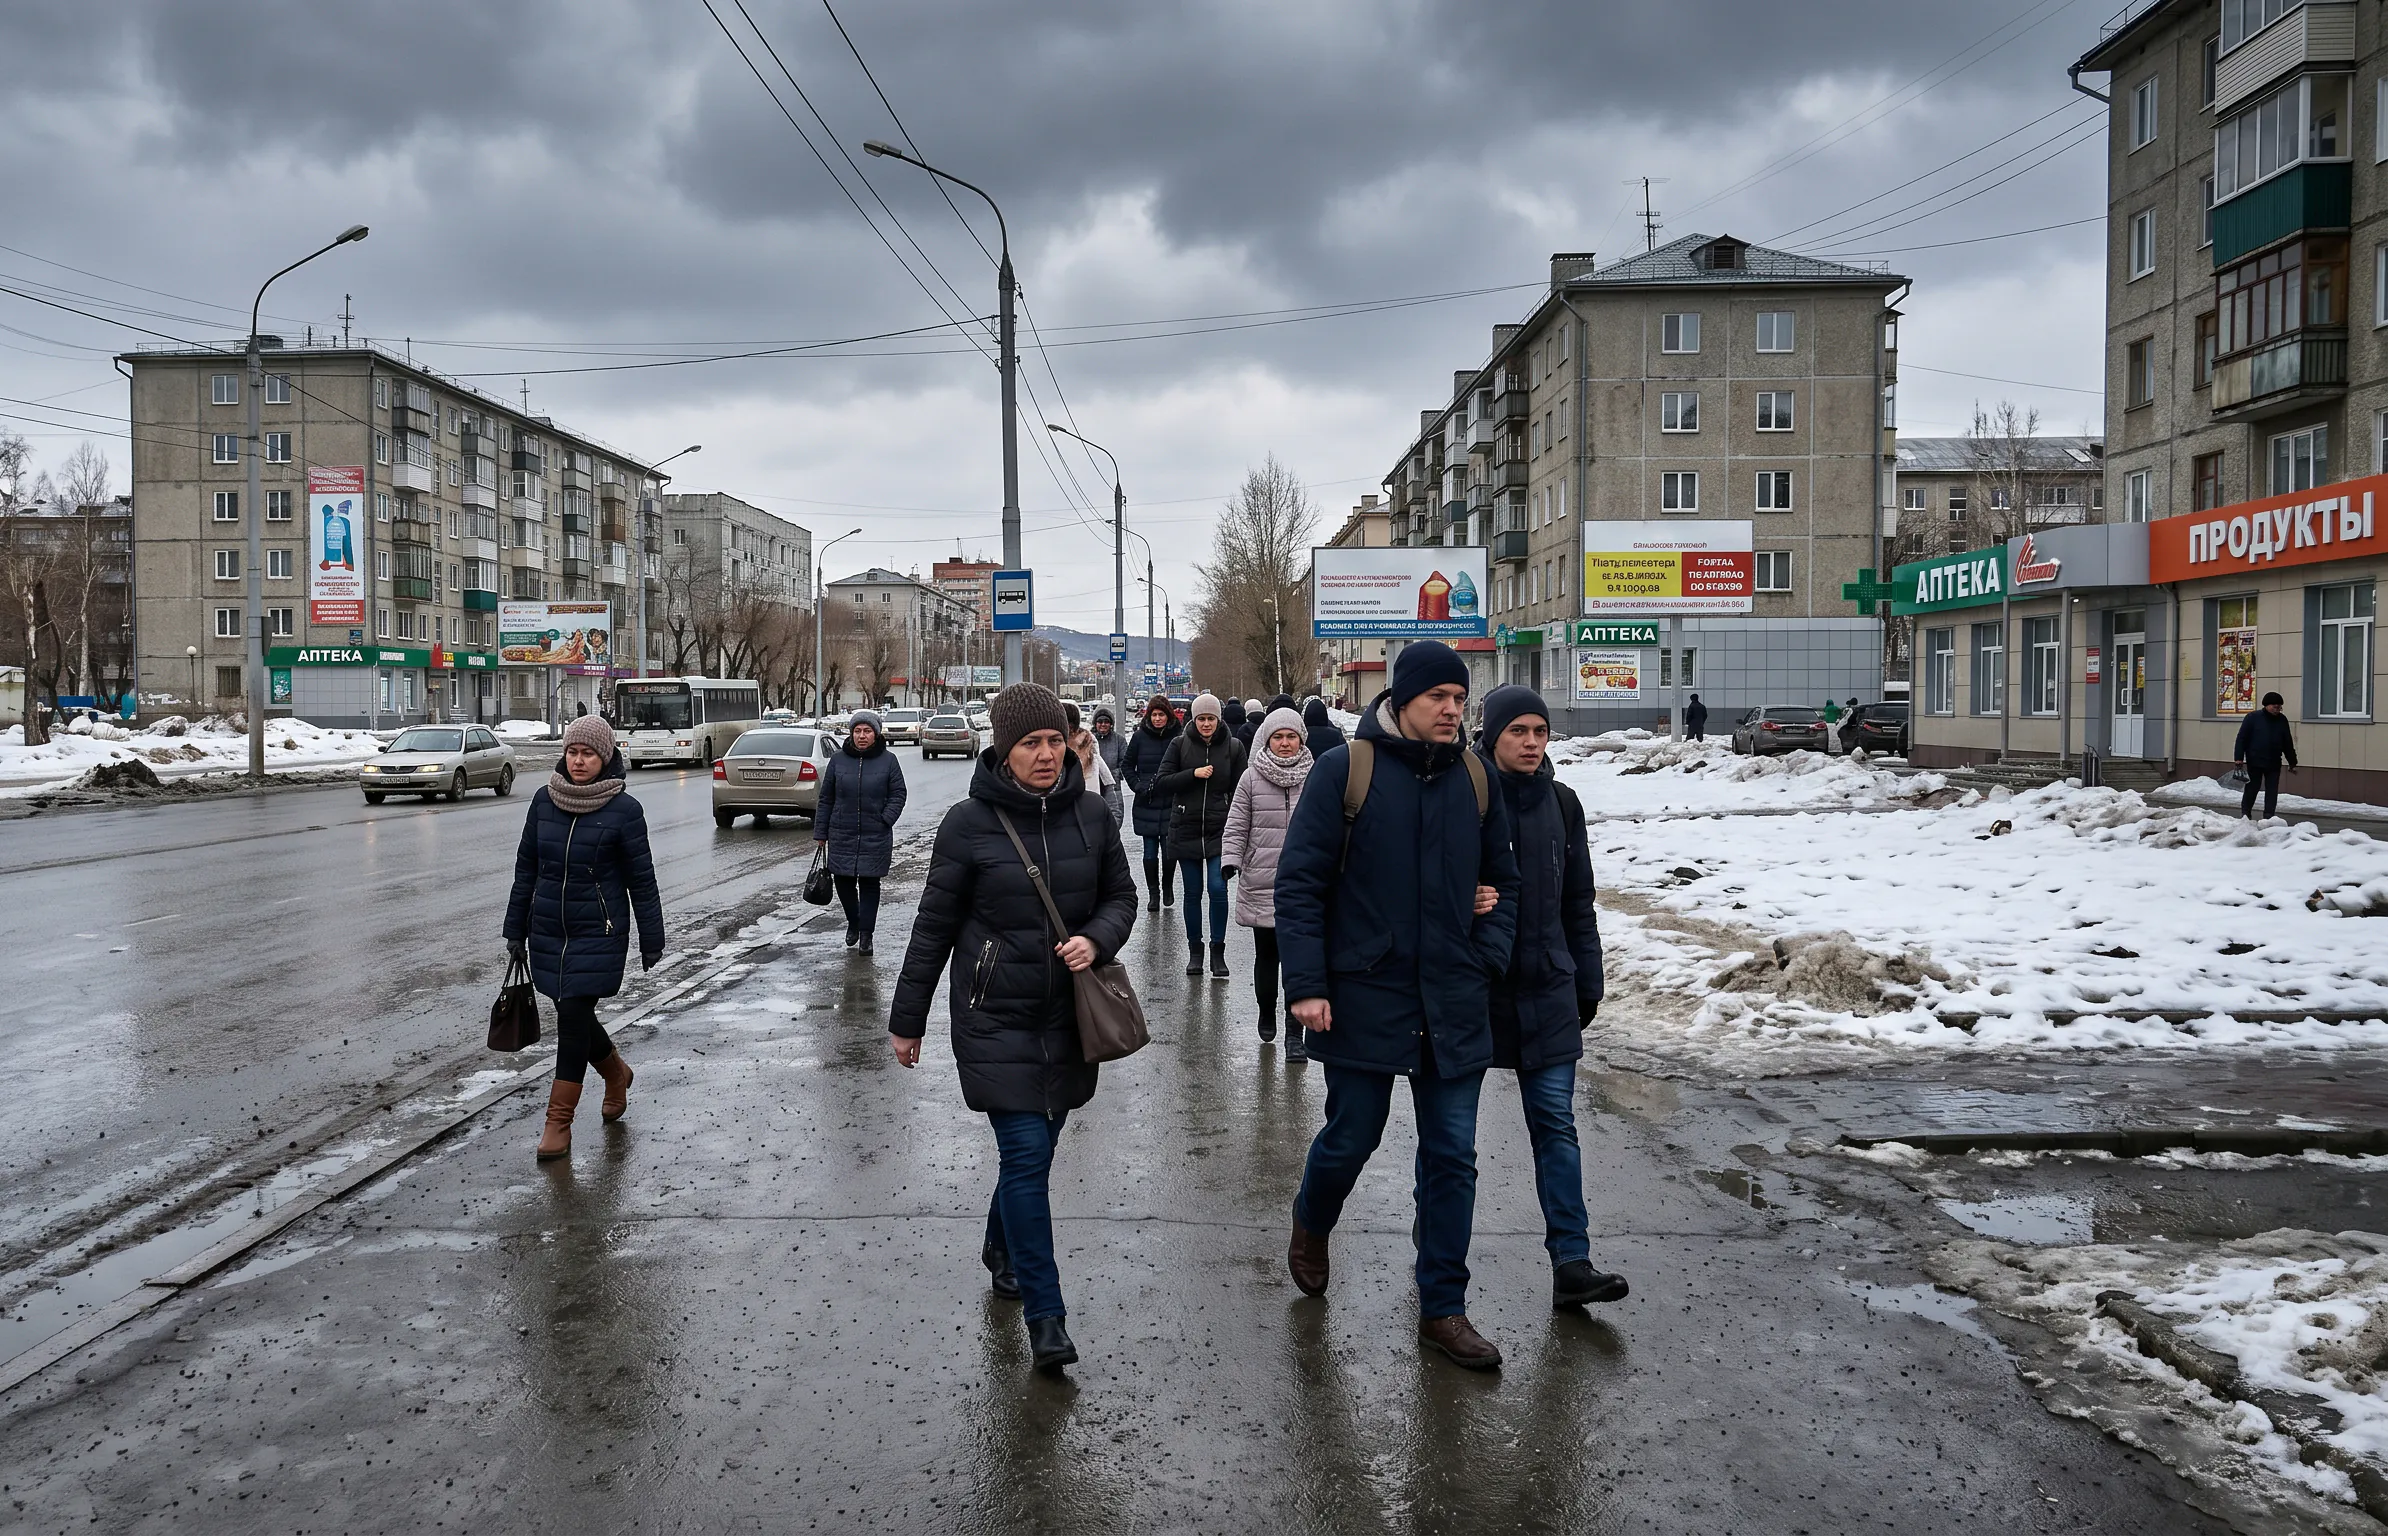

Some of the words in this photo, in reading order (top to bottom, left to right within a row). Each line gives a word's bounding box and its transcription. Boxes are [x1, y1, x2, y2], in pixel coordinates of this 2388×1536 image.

[2189, 491, 2375, 564] ПРОДУКТЫ
[1915, 557, 2001, 604] АПТЕКА
[1580, 627, 1656, 641] АПТЕКА
[297, 649, 364, 662] АПТЕКА
